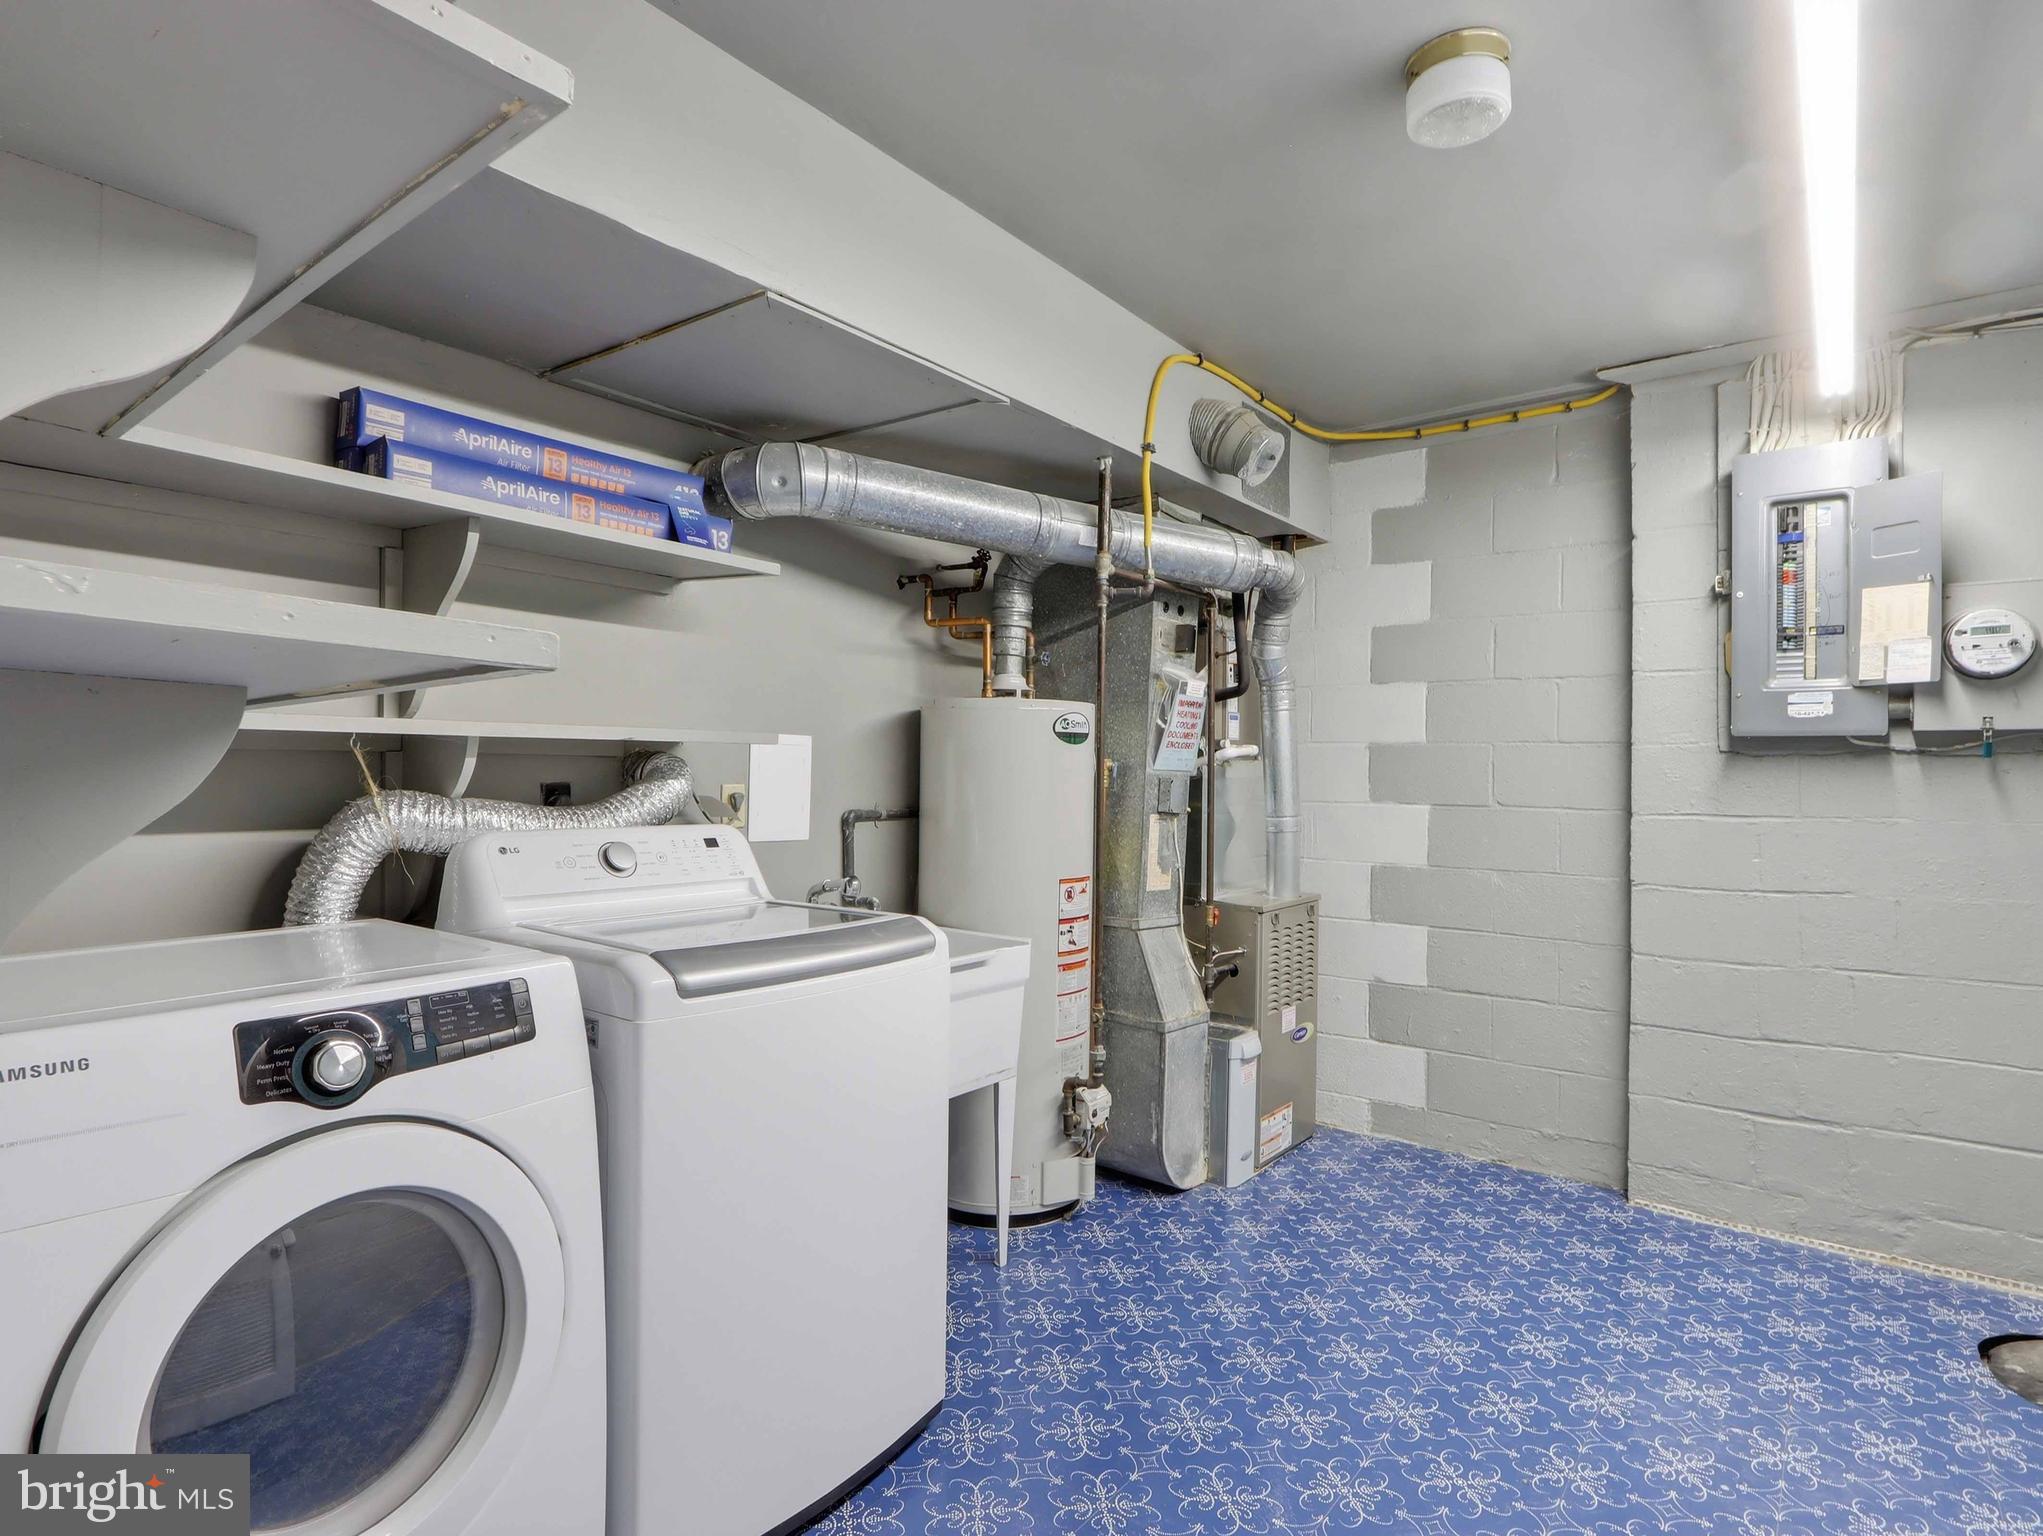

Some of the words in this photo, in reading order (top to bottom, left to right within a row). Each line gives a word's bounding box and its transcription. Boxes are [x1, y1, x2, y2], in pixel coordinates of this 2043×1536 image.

[452, 428, 533, 459] AprilAire
[496, 457, 508, 466] Air
[510, 459, 531, 472] Filter
[571, 456, 608, 473] Healthy
[609, 463, 622, 475] Air
[480, 476, 561, 505] AprilAire
[600, 501, 635, 518] Healthy
[636, 508, 649, 519] Air
[711, 528, 729, 550] 13
[273, 1046, 295, 1055] Normal
[256, 1063, 275, 1071] Heavy
[276, 1060, 291, 1068] Duty
[265, 1087, 293, 1097] Delicates
